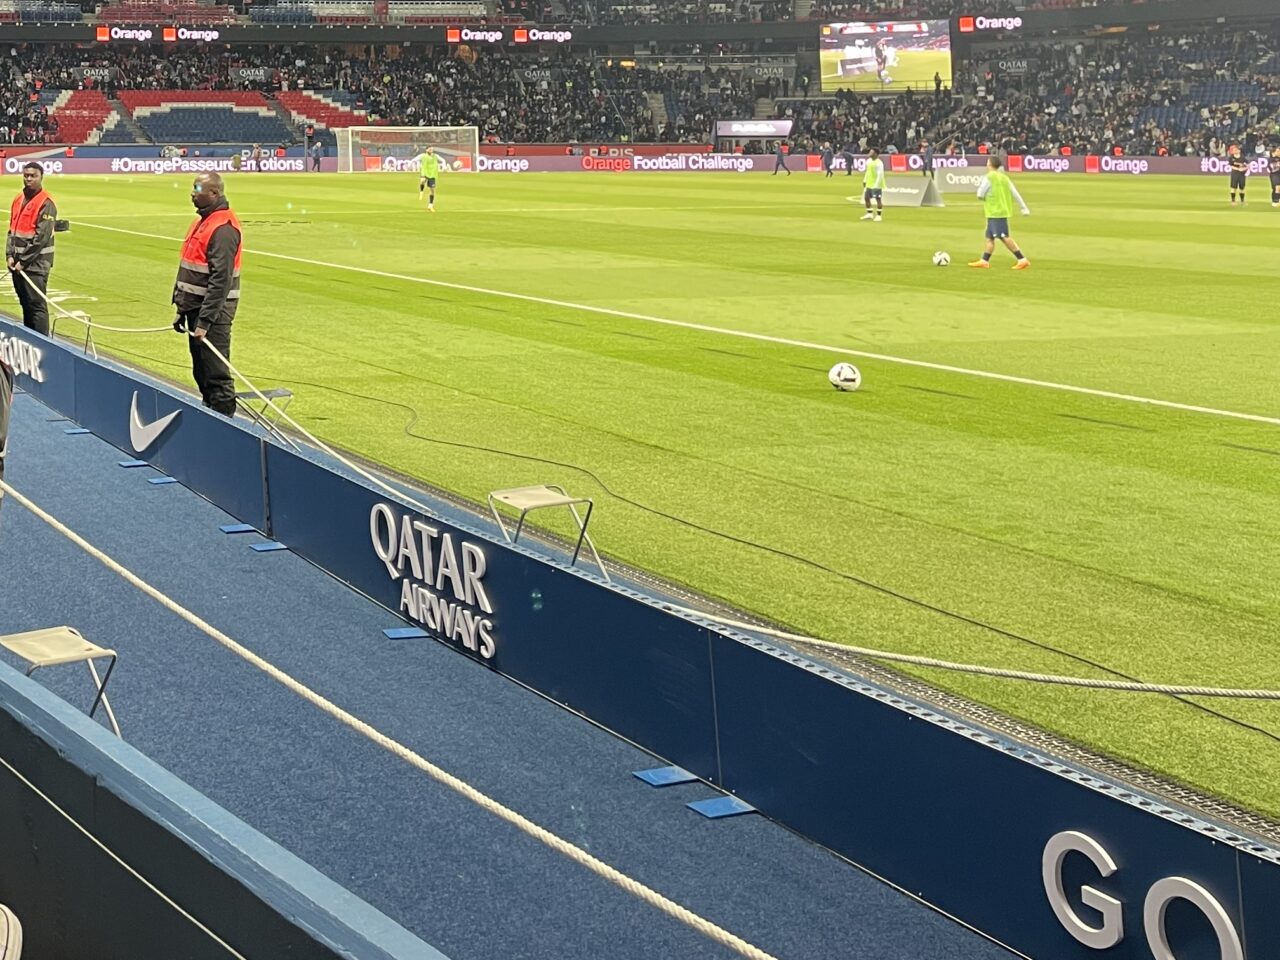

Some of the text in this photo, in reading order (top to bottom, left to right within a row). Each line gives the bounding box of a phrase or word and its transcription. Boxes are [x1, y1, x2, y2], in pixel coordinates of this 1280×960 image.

[975, 16, 1022, 29] Orange
[110, 26, 153, 41] Orange
[177, 27, 219, 42] Orange
[461, 29, 503, 43] Orange
[529, 29, 572, 43] Orange
[83, 68, 110, 77] QATAR
[239, 68, 265, 78] QATAR
[755, 67, 784, 77] QATAR
[999, 61, 1028, 70] QATAR
[524, 70, 551, 79] QATAR
[5, 158, 63, 175] Orge
[477, 156, 529, 172] Orange
[582, 155, 754, 172] Orange Football Challenge
[908, 154, 968, 169] Oange
[1024, 155, 1070, 173] Orange
[1101, 155, 1149, 172] Orange
[945, 172, 985, 187] Orang
[370, 503, 493, 614] QATAR
[400, 578, 496, 659] AIRWAYS
[1042, 830, 1244, 960] GO
